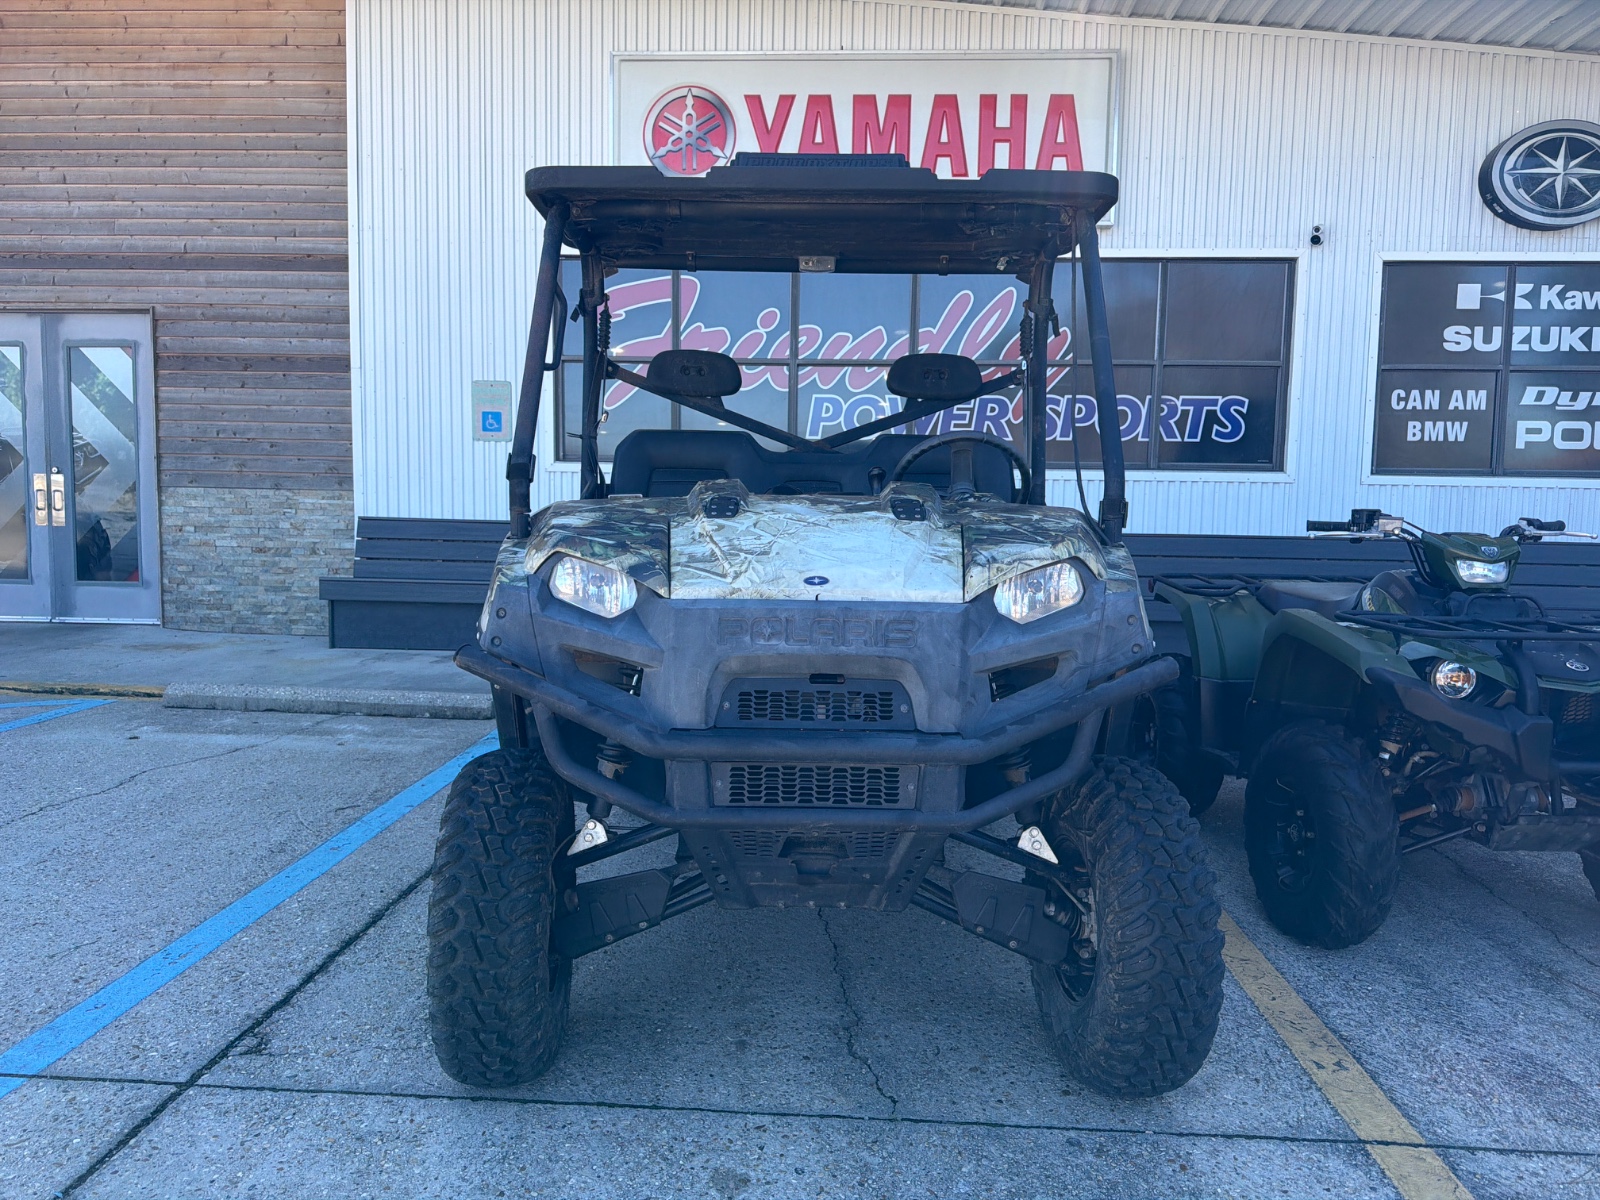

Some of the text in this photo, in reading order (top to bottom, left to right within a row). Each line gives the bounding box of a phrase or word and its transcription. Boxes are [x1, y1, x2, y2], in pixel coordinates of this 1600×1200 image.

[744, 94, 1084, 177] YAMAHA
[1391, 388, 1487, 411] CAN AM
[1406, 421, 1468, 442] BMW
[717, 617, 920, 648] POLARIS
